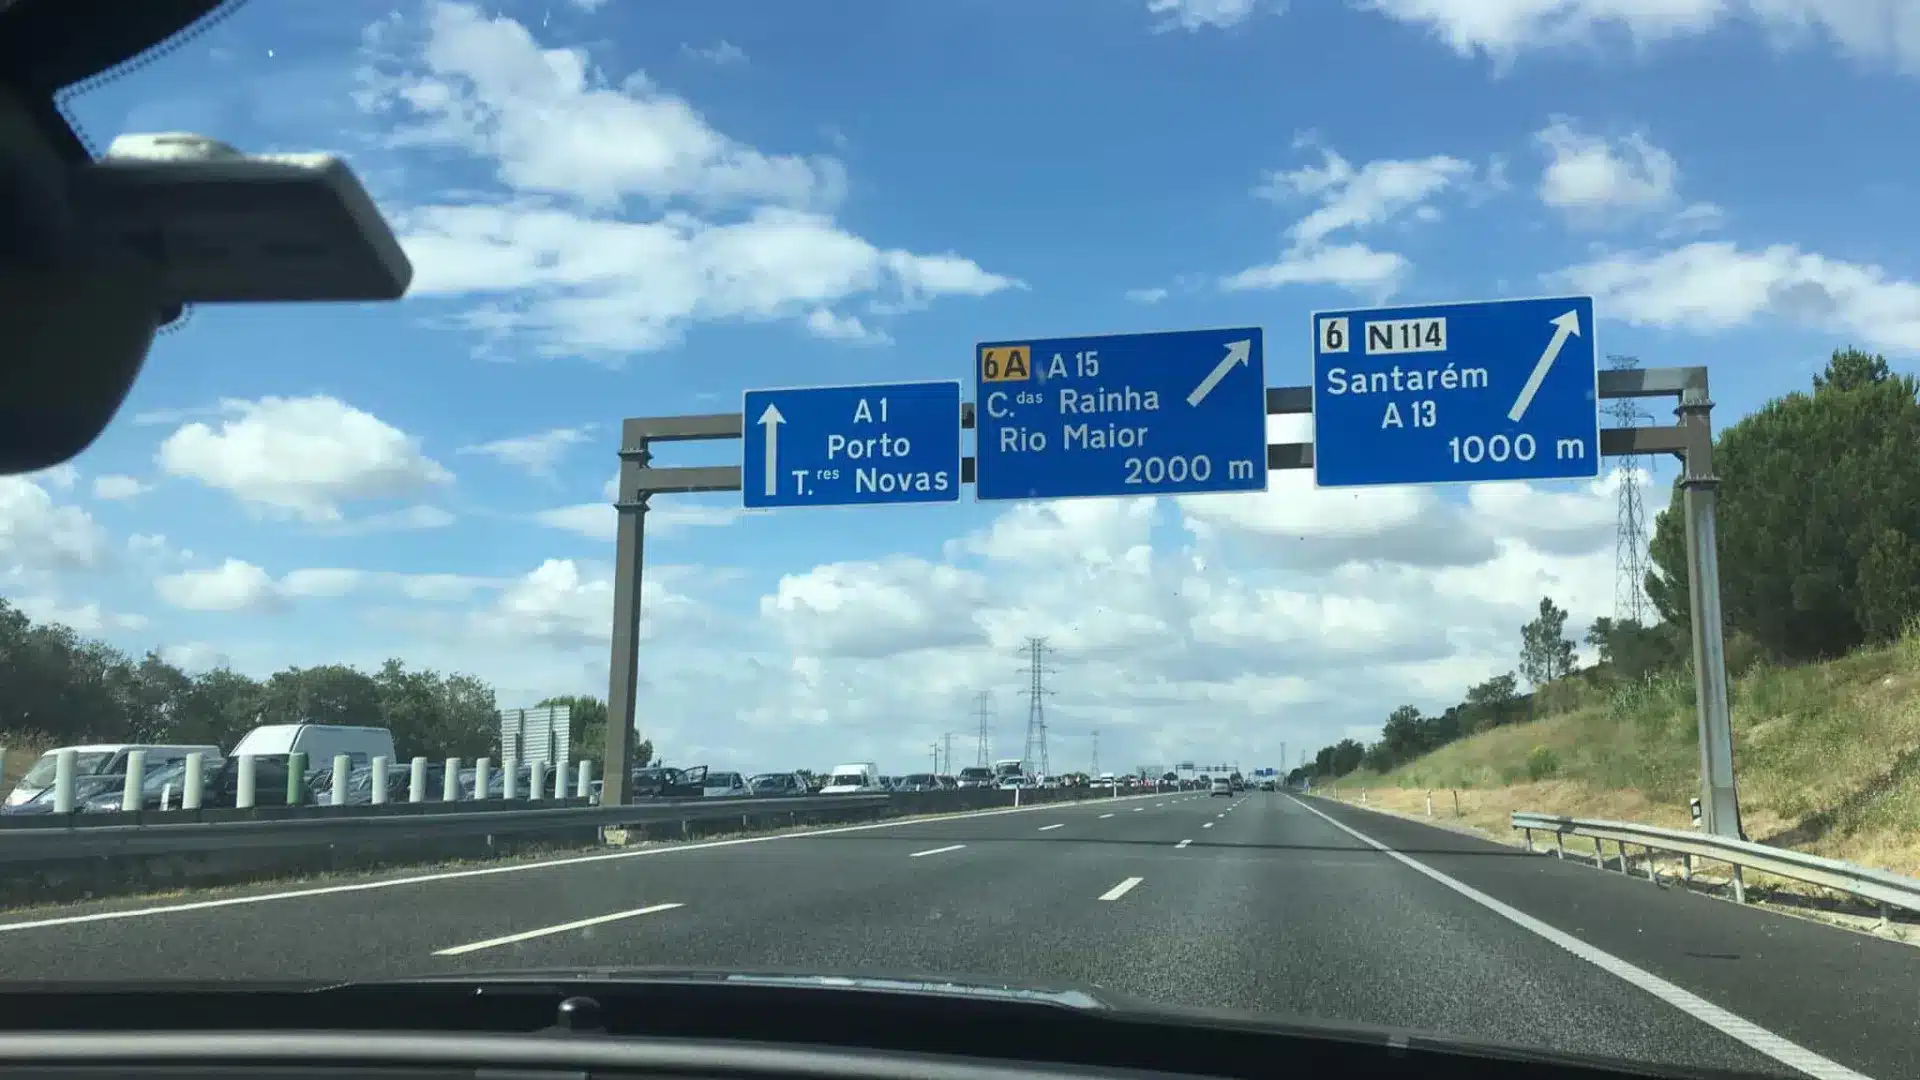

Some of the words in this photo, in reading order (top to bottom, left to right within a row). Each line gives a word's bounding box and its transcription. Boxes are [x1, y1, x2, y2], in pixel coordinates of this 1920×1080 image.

[1326, 321, 1343, 349] 6
[1369, 321, 1442, 351] N114
[1327, 362, 1488, 395] Santarém
[1059, 384, 1159, 415] Rainha
[827, 433, 911, 460] Porto
[1000, 426, 1046, 452] Rio
[1063, 423, 1148, 451] Maior
[1449, 433, 1536, 464] 1000
[1557, 437, 1584, 460] m
[855, 467, 948, 493] Novas
[1124, 455, 1211, 484] 2000
[1229, 459, 1254, 480] m
